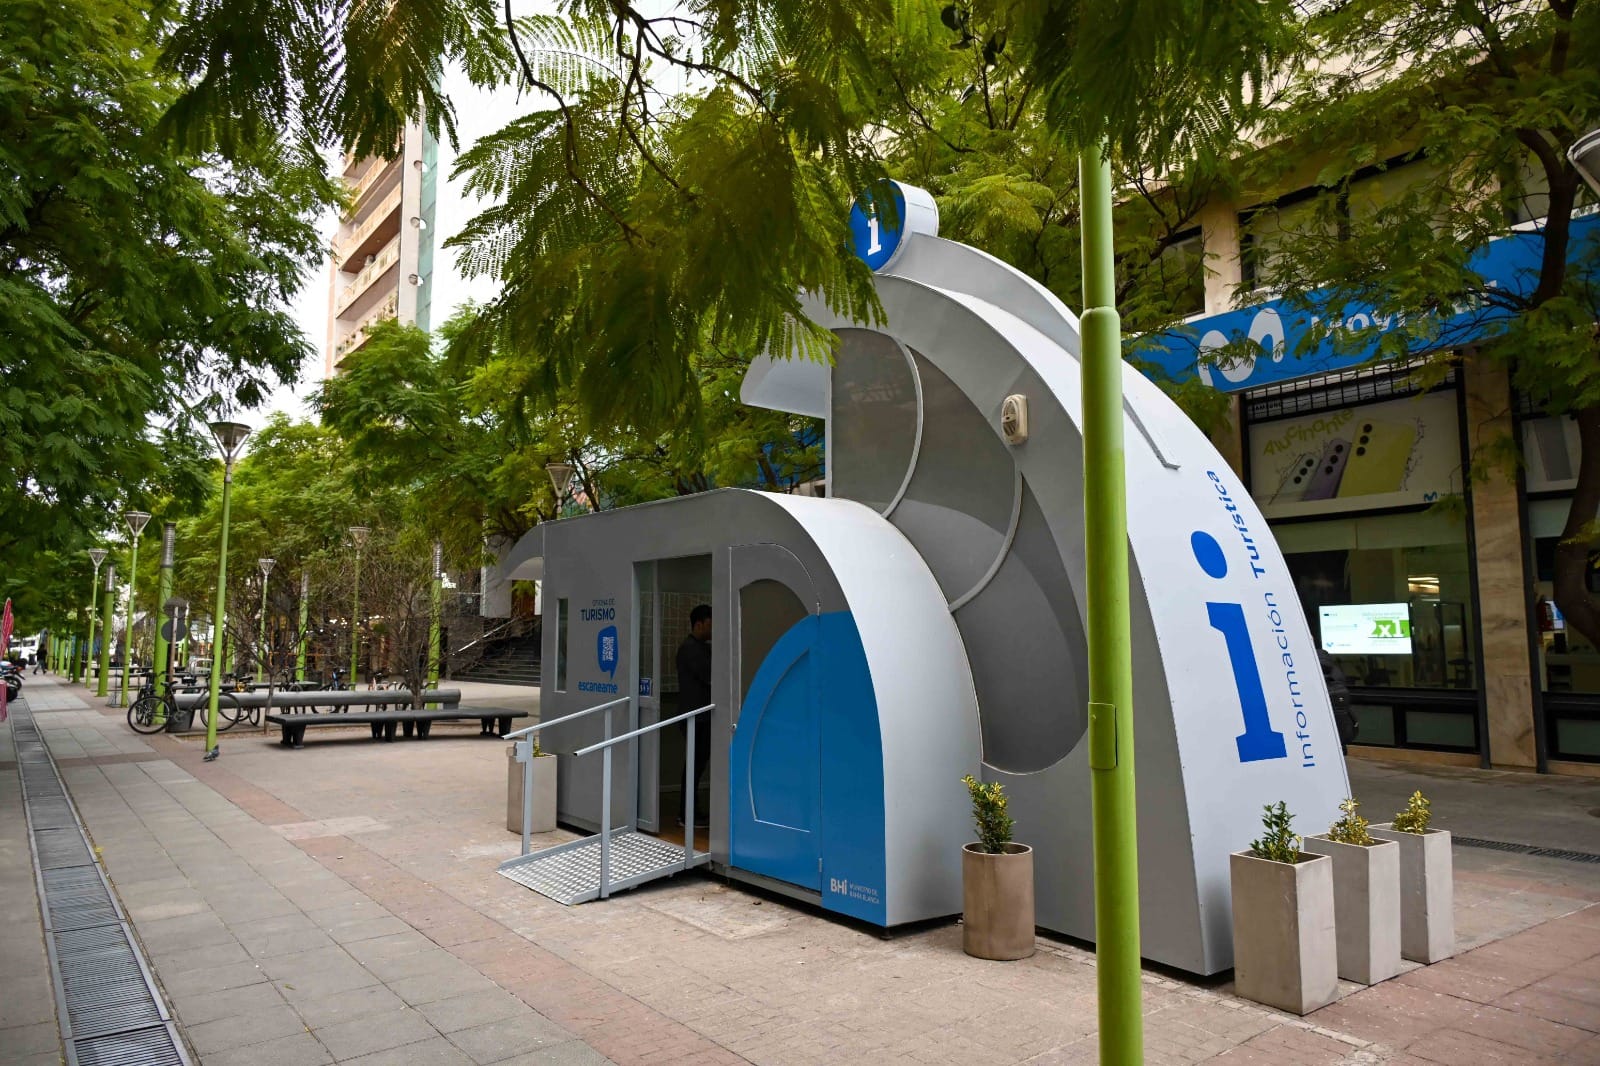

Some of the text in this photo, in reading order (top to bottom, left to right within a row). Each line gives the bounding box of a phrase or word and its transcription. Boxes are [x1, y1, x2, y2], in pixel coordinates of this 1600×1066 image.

[580, 607, 615, 621] TURISMO
[1206, 470, 1316, 768] Información Turística
[578, 681, 618, 694] escaneame
